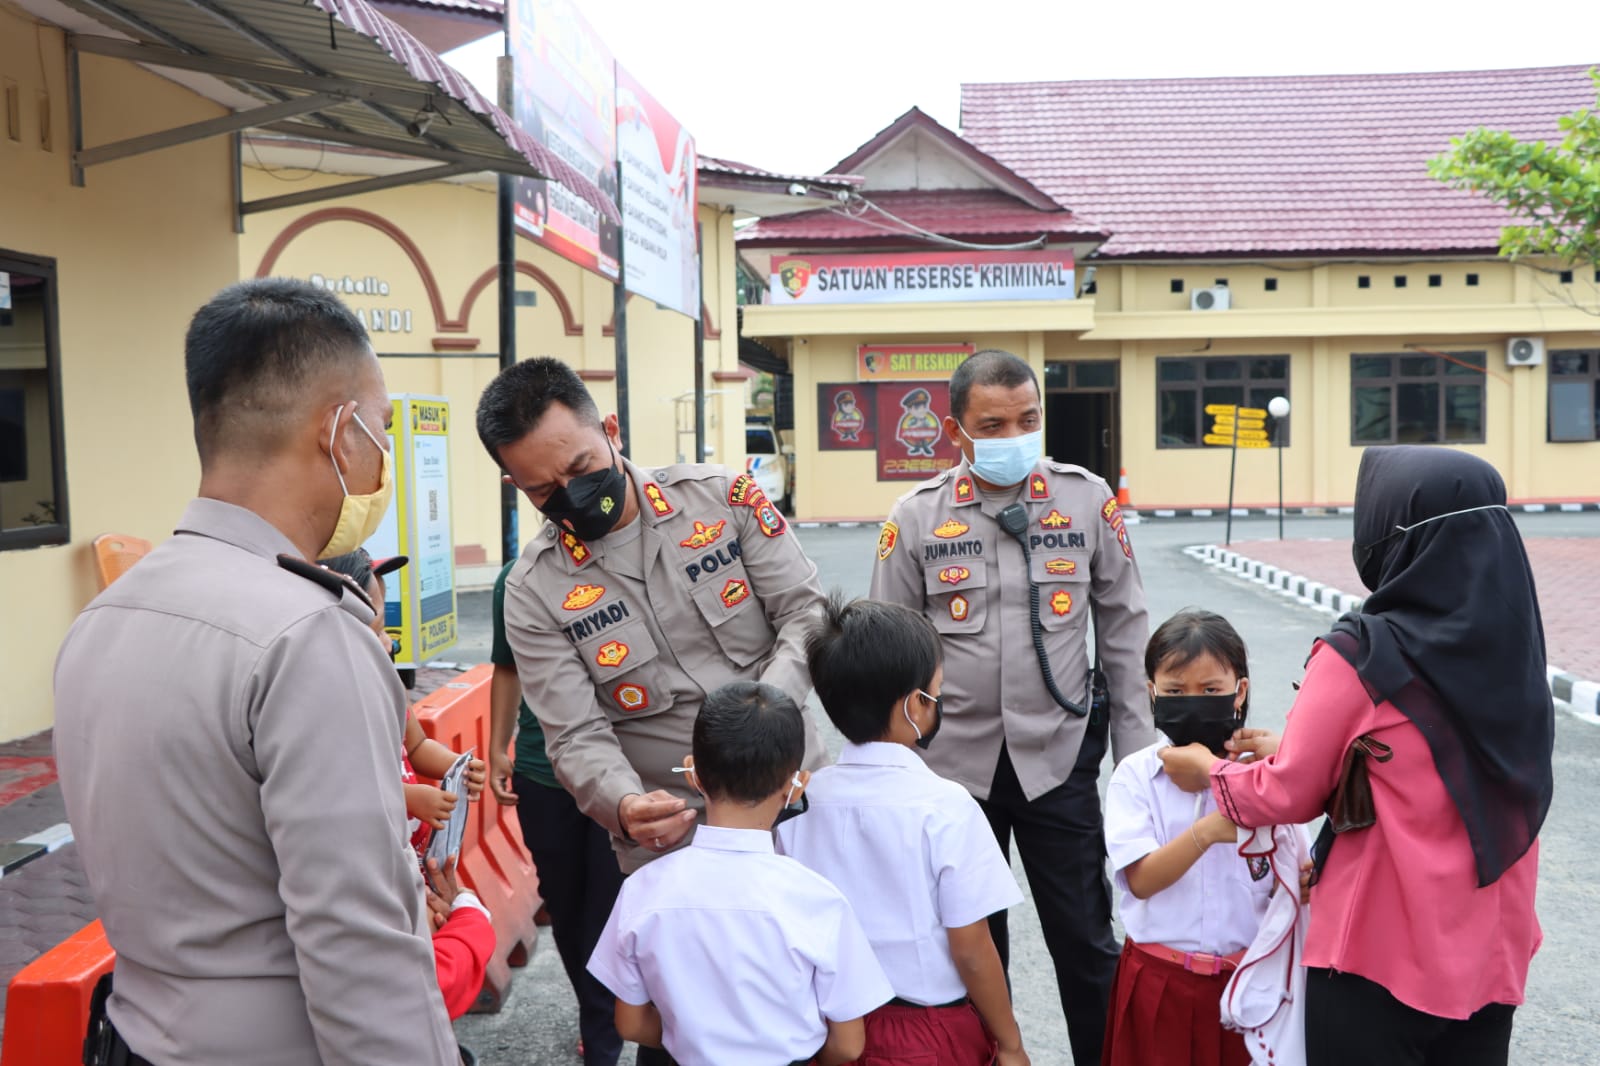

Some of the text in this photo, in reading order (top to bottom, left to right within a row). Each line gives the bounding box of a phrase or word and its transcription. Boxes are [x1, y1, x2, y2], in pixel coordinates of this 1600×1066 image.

[817, 263, 1066, 291] SATUAN RESERSE KRIMINAL
[356, 308, 412, 333] ANDI
[890, 353, 912, 371] SAT
[419, 405, 440, 422] MASUK
[924, 540, 983, 560] JUMANTO
[1030, 532, 1086, 550] POLRI
[563, 600, 630, 643] TRIYADI
